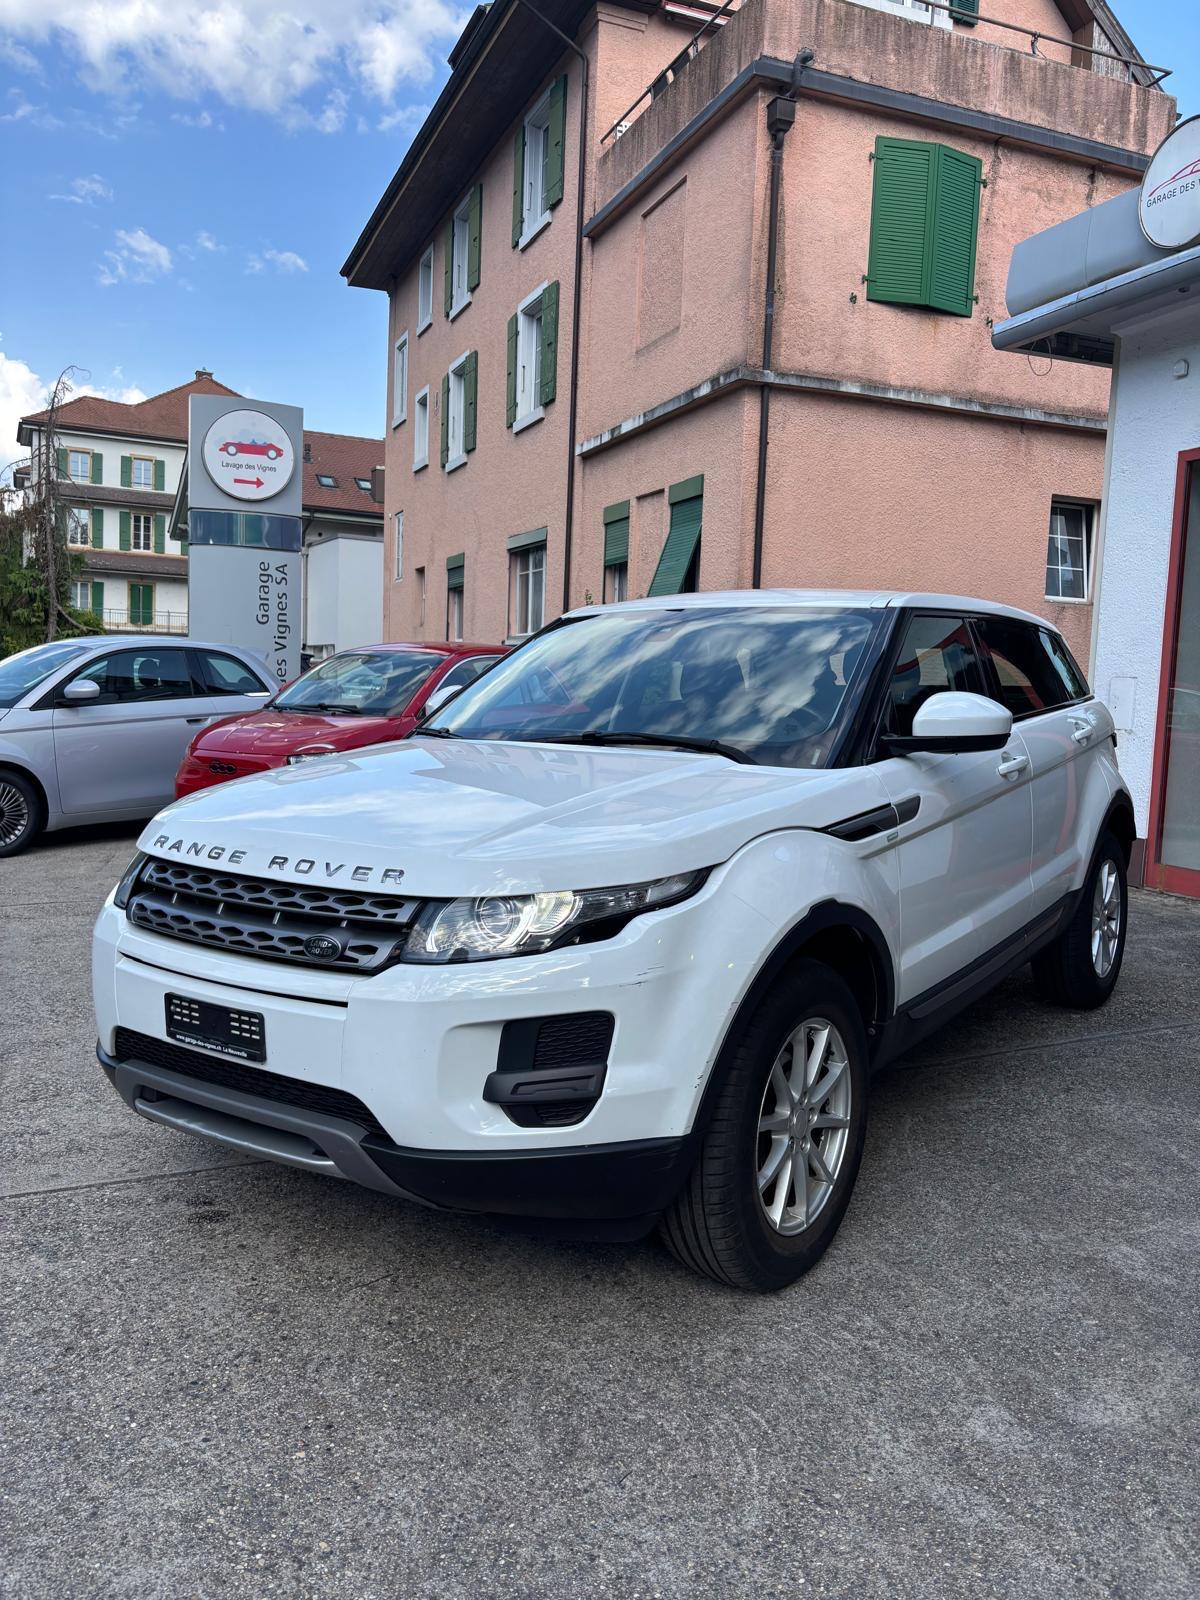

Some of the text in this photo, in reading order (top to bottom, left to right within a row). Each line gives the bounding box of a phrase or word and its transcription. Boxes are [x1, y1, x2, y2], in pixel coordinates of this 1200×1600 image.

[1146, 188, 1177, 207] GARAGE
[1180, 181, 1195, 194] DES
[221, 460, 276, 472] Lavage des Vignes
[256, 561, 273, 625] Garage
[275, 563, 288, 586] SA
[274, 592, 290, 652] Vignes
[153, 834, 406, 885] RANGE ROVER
